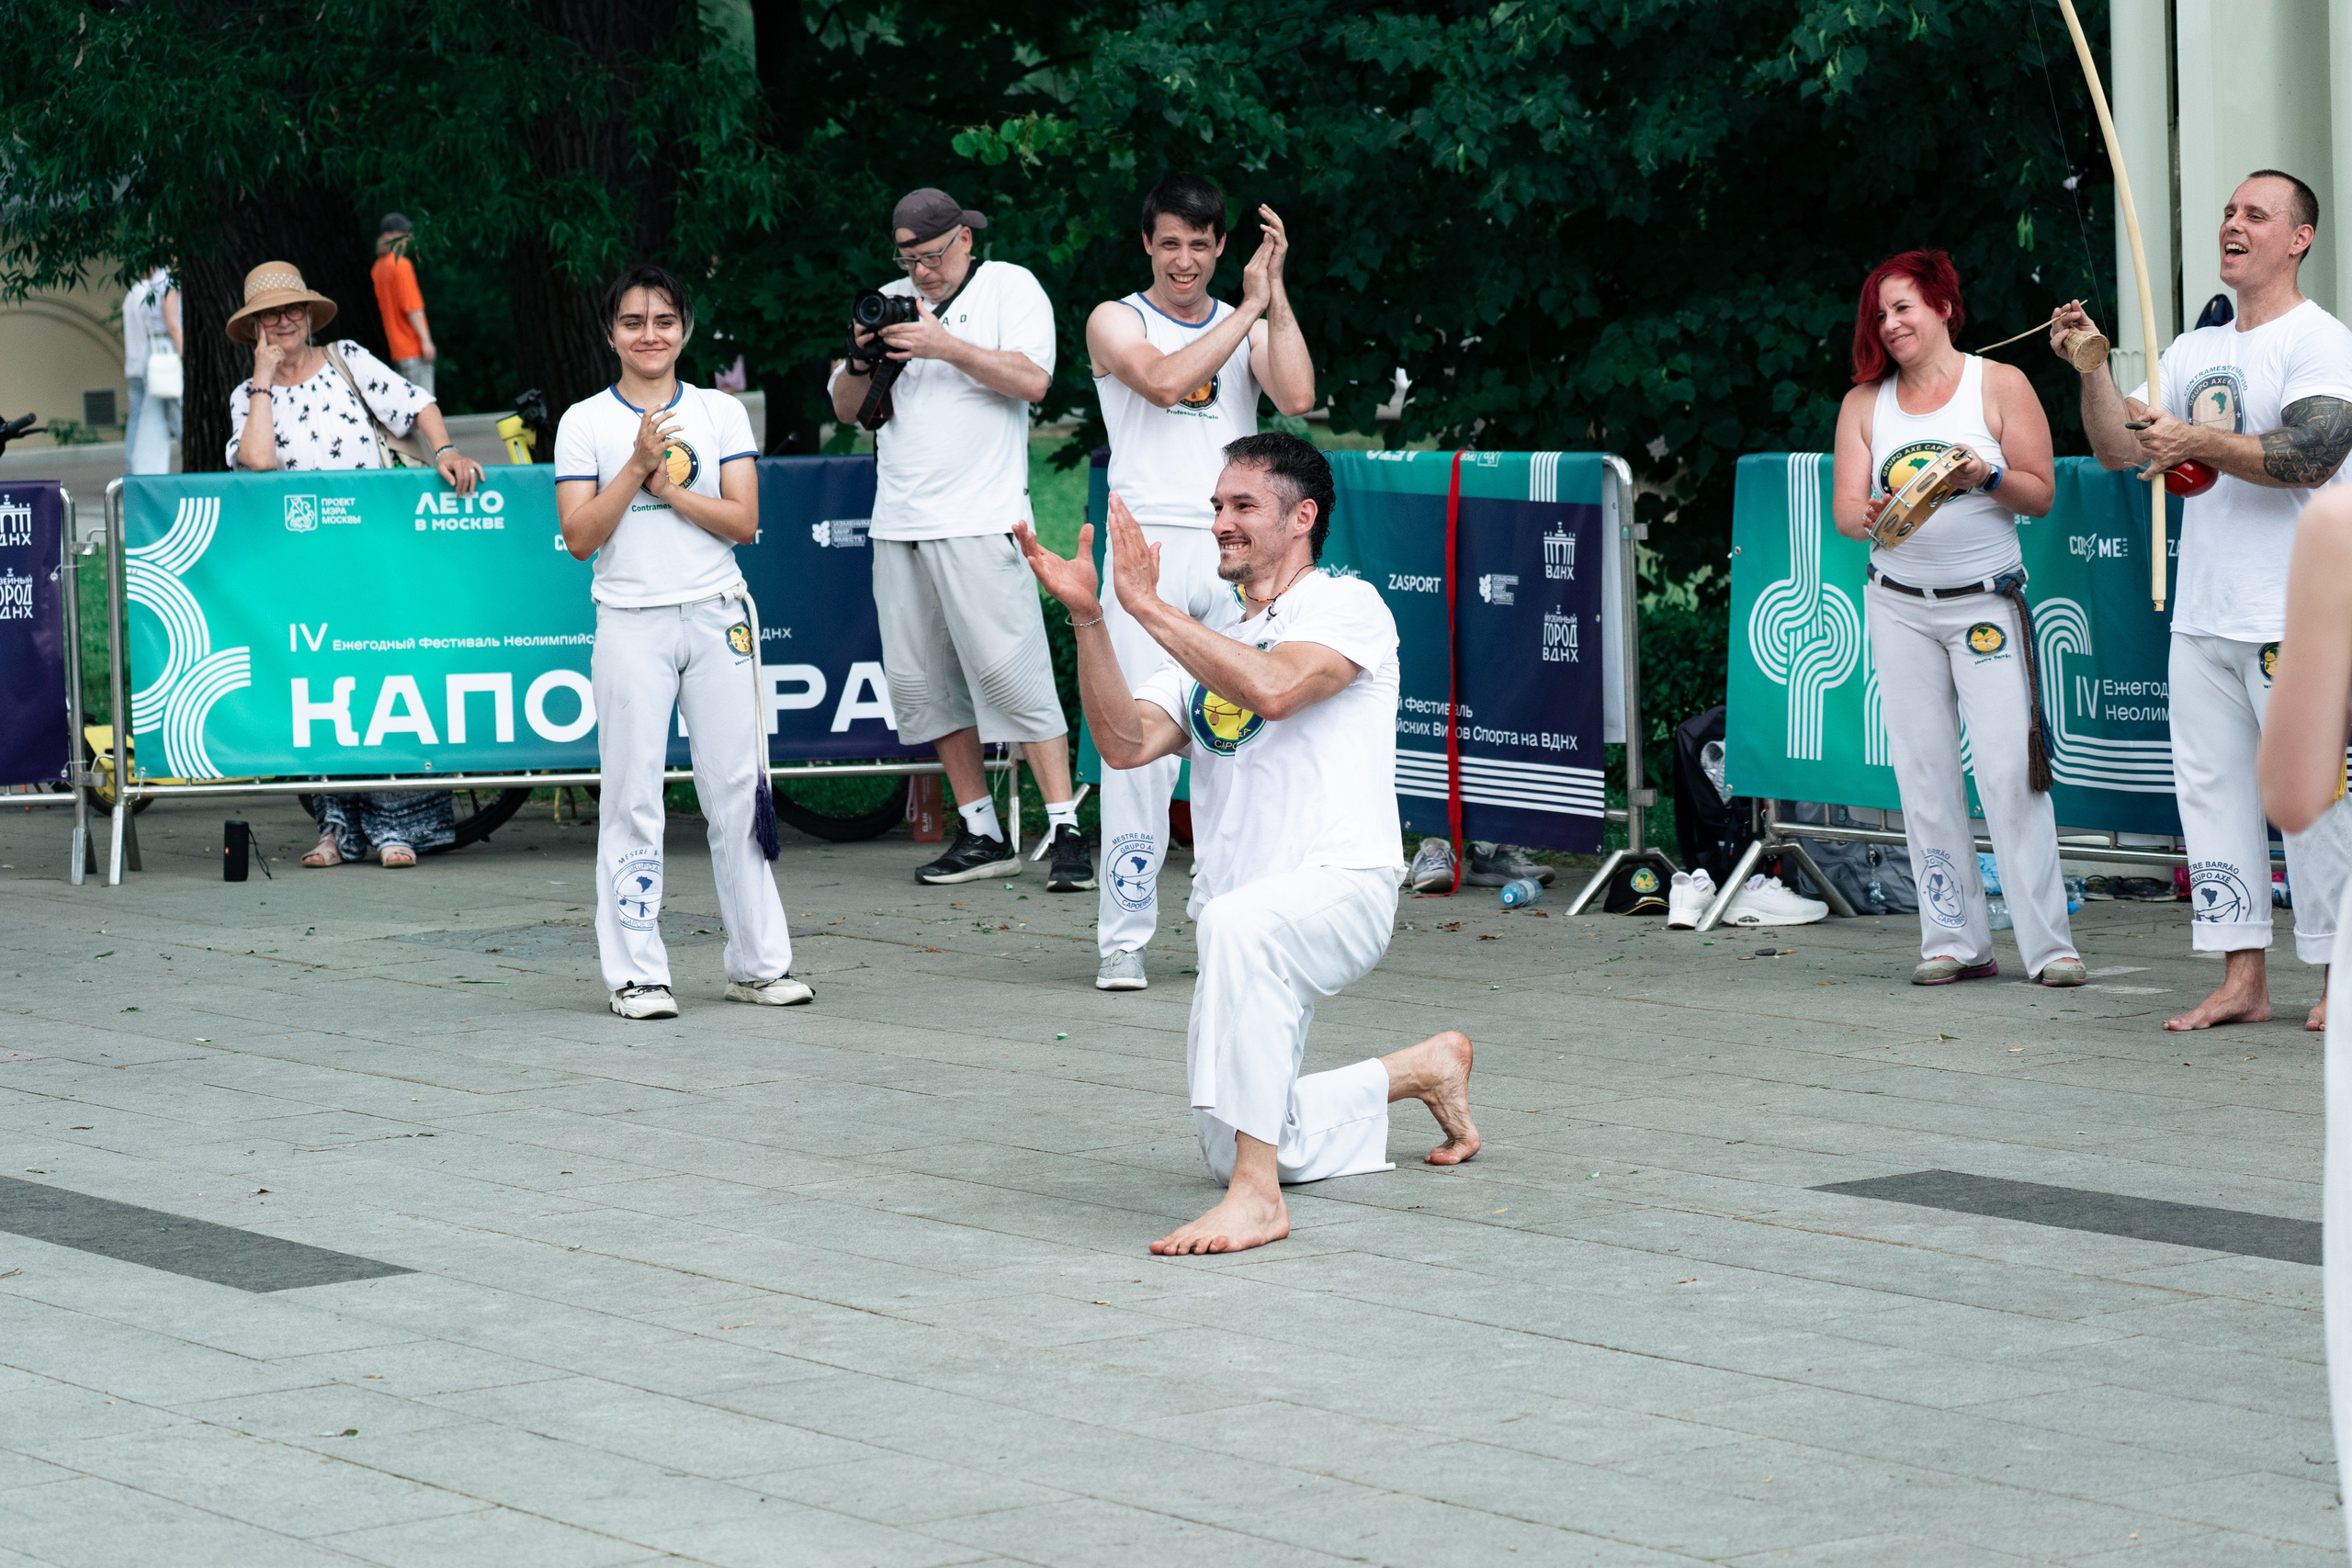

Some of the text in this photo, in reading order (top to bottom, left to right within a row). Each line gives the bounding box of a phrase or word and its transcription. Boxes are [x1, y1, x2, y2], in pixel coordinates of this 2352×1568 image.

[2188, 381, 2209, 406] GRUPO
[1166, 408, 1197, 417] Professor
[1882, 453, 1903, 478] GRUPO
[1904, 444, 1922, 455] AXÉ
[321, 497, 356, 507] ПРОЕКТ
[414, 490, 504, 515] ЛЕТО
[322, 507, 347, 515] МЭРА
[322, 515, 362, 525] МОСКВЫ
[414, 516, 505, 531] В МОСКВЕ
[1545, 564, 1575, 581] ВДНХ
[1388, 573, 1442, 593] ZASPORT
[289, 622, 329, 653] IV
[333, 635, 415, 651] Ежегодный
[418, 636, 501, 649] Фестиваль
[1544, 623, 1578, 648] ГОРОД
[1542, 647, 1579, 663] ВДНХ
[2075, 674, 2169, 719] IV Ежегод
[290, 661, 899, 749] КАПОРА
[1432, 721, 1471, 740] Виов
[1473, 726, 1517, 746] Спорта
[1521, 732, 1539, 747] на
[1541, 732, 1578, 751] ВДНХ
[1112, 832, 1138, 845] MESTRE
[1120, 842, 1146, 853] GRUPO
[617, 848, 649, 865] MESTRE
[628, 863, 654, 873] GRUPO
[2205, 861, 2240, 874] BARRÃO
[2214, 873, 2232, 885] AXÉ
[1121, 897, 1153, 909] CAPOEIRA
